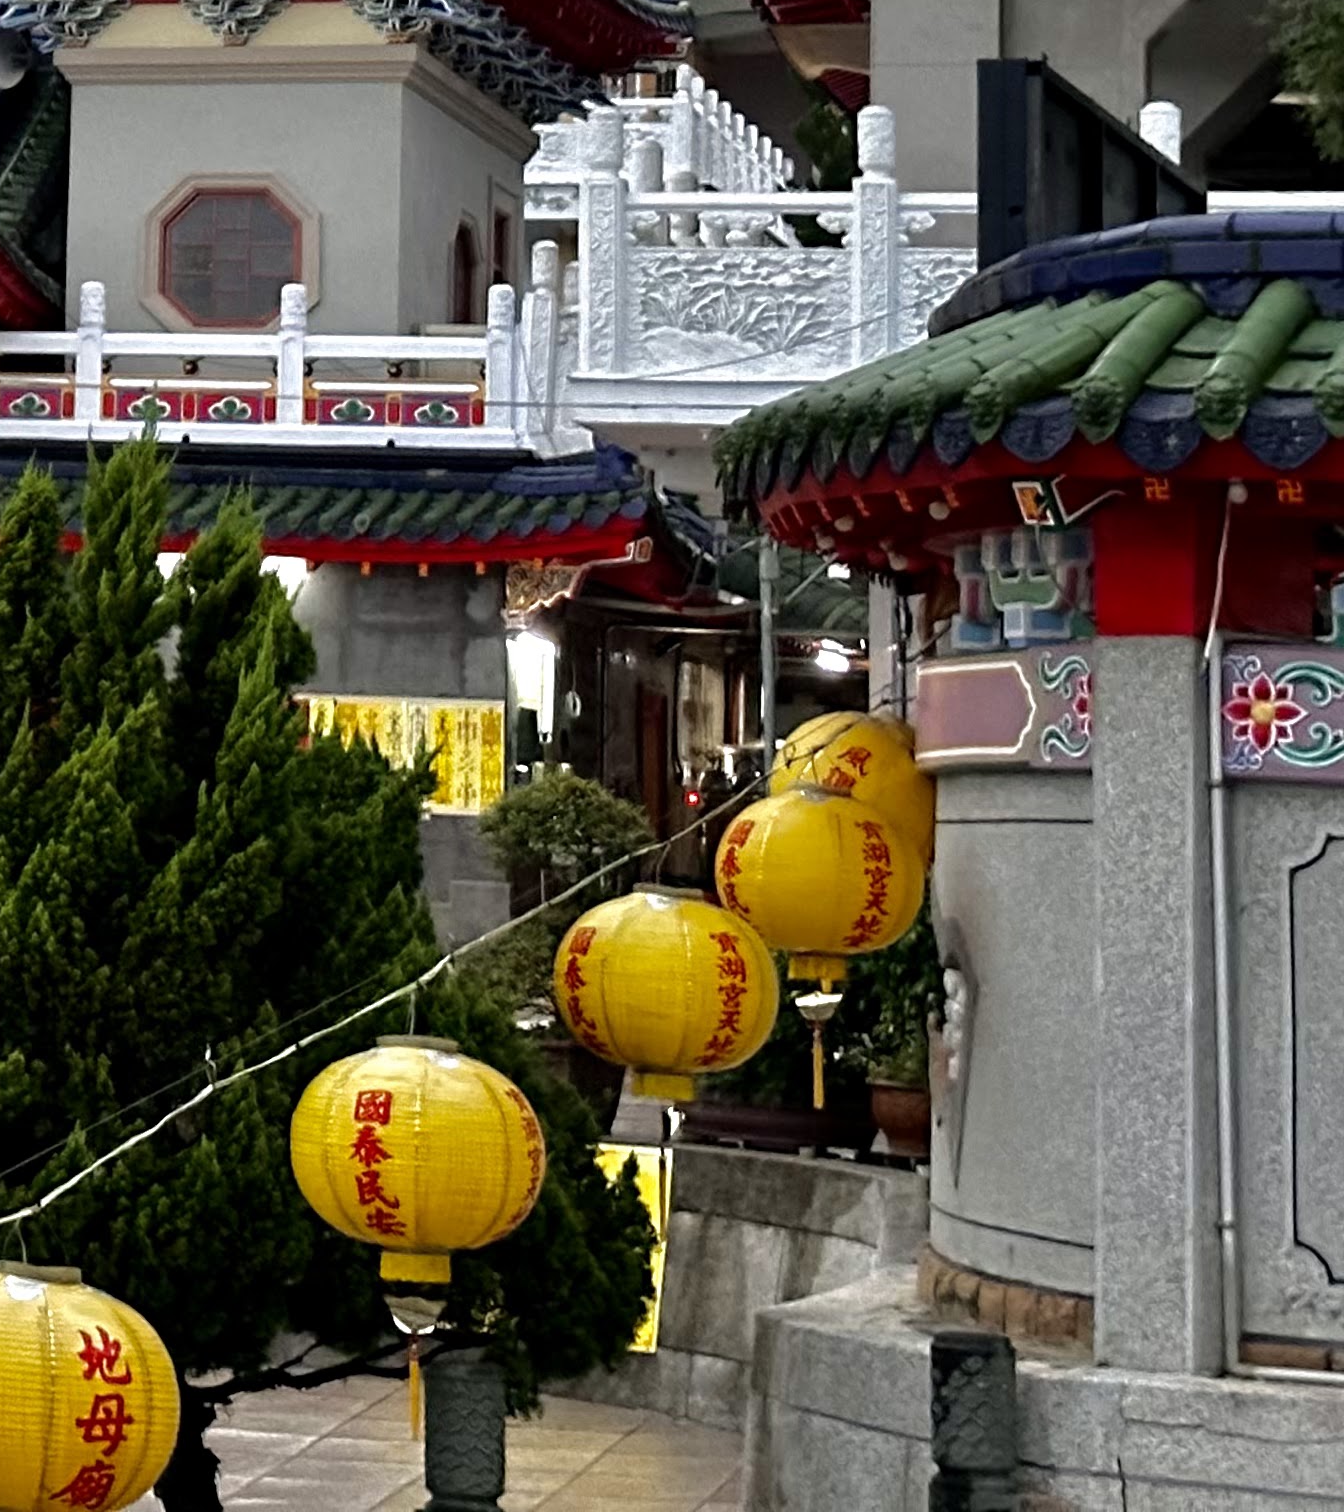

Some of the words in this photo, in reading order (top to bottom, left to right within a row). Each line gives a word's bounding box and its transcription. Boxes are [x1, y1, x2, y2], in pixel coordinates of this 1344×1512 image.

[720, 819, 758, 921] 國泰民
[349, 1089, 408, 1236] 國泰民安
[48, 1325, 135, 1510] 地母廟
